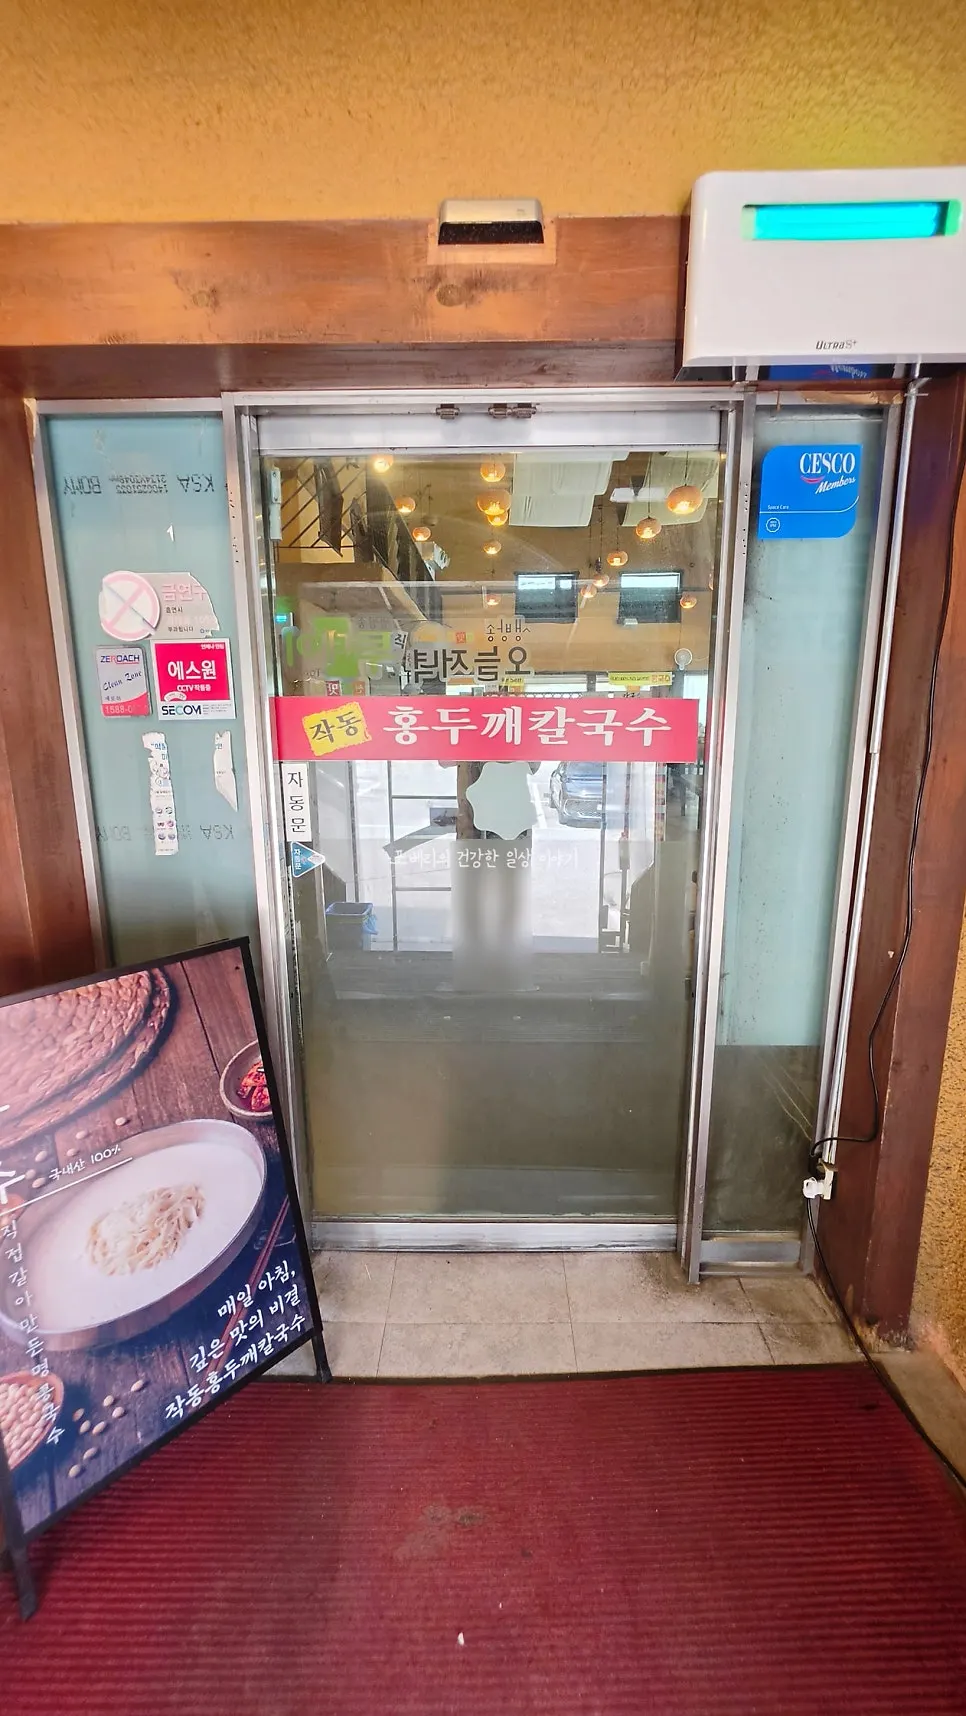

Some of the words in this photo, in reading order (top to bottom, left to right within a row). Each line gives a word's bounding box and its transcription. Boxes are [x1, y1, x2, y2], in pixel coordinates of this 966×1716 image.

[799, 451, 856, 475] CESCO
[815, 475, 856, 495] Members
[100, 654, 140, 663] ZEROACH
[167, 659, 217, 681] 에스원
[103, 678, 123, 692] Clean
[124, 670, 143, 682] Zone
[161, 704, 202, 716] SECOM
[309, 710, 362, 744] 작동
[382, 704, 673, 747] 홍두깨칼국수
[287, 770, 307, 833] 자동문
[48, 1158, 86, 1181] 국내산
[90, 1144, 121, 1165] 100%
[217, 1283, 254, 1318] 매일
[258, 1259, 296, 1292] 아침,
[189, 1337, 226, 1374] 깊은
[229, 1309, 264, 1347] 맛의
[269, 1284, 301, 1315] 비결
[165, 1313, 306, 1421] 작동홍두깨칼국수
